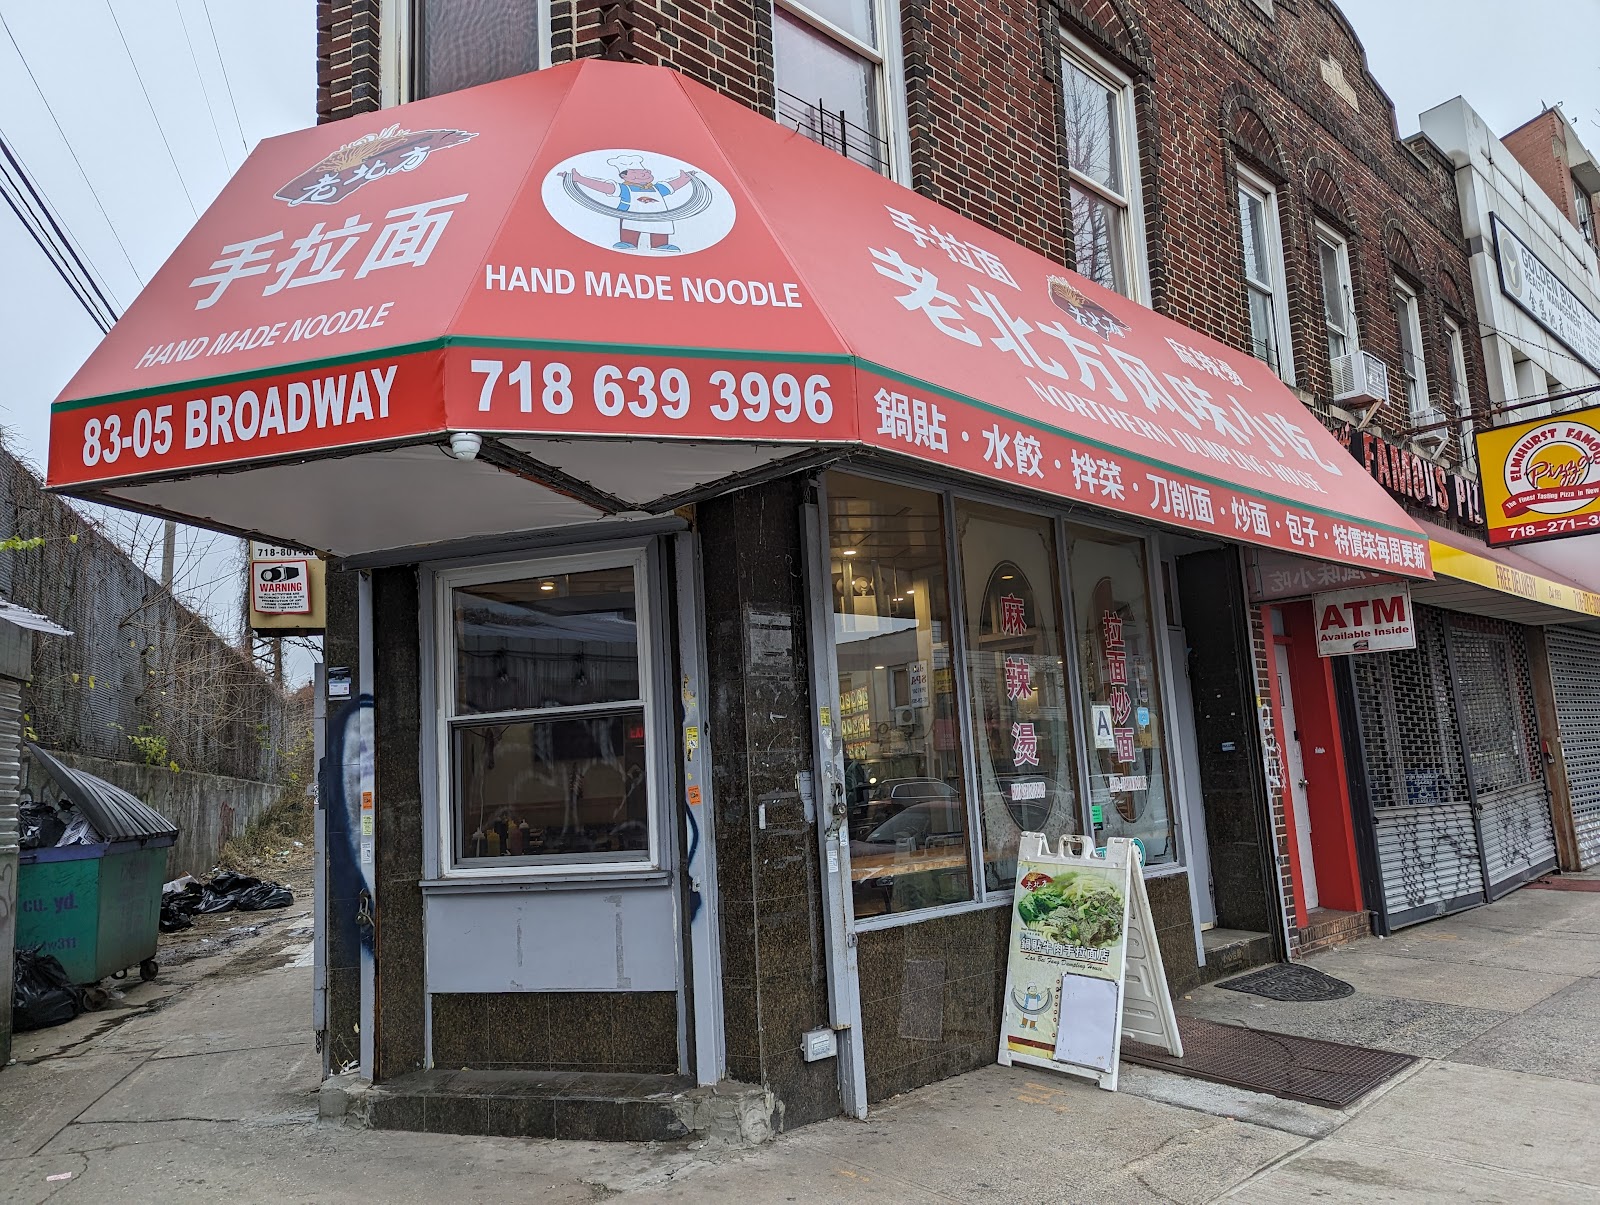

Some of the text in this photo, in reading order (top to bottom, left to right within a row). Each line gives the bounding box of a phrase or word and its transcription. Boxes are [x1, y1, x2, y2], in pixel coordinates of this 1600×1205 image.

[188, 193, 468, 310] 手拉面
[884, 204, 1022, 291] 手拉面
[485, 264, 803, 308] HAND MADE NOODLE
[1521, 247, 1558, 297] GOLDEN
[1560, 286, 1581, 320] BULL
[135, 302, 395, 370] HAND MADE NOODLE
[868, 246, 1343, 476] 老北方风味小吃
[82, 365, 398, 466] 83-05 BROADWAY
[470, 359, 834, 424] 718 639 3996
[874, 387, 948, 454] 鍋貼
[982, 423, 1045, 480] 水餃
[1071, 449, 1126, 501] 拌菜
[1146, 473, 1215, 525] 刀削面
[1231, 497, 1272, 538] 炒面
[1285, 511, 1319, 548] 包子
[1025, 376, 1176, 447] NORTHERN
[1171, 428, 1272, 478] DUMPLING
[1268, 460, 1329, 494] HOUSE
[1510, 428, 1557, 482] ELMHURST
[1506, 501, 1517, 509] The
[1518, 494, 1535, 503] Finest
[1537, 491, 1558, 500] Tasting
[1560, 489, 1574, 498] Pizza
[1524, 454, 1595, 487] Pizza
[1507, 515, 1600, 539] 718-271-3
[260, 582, 302, 592] WARNING
[1320, 596, 1405, 631] ATM
[1321, 626, 1409, 642] Available Inside
[1103, 610, 1136, 763] 拉面炒面
[1097, 710, 1110, 736] A
